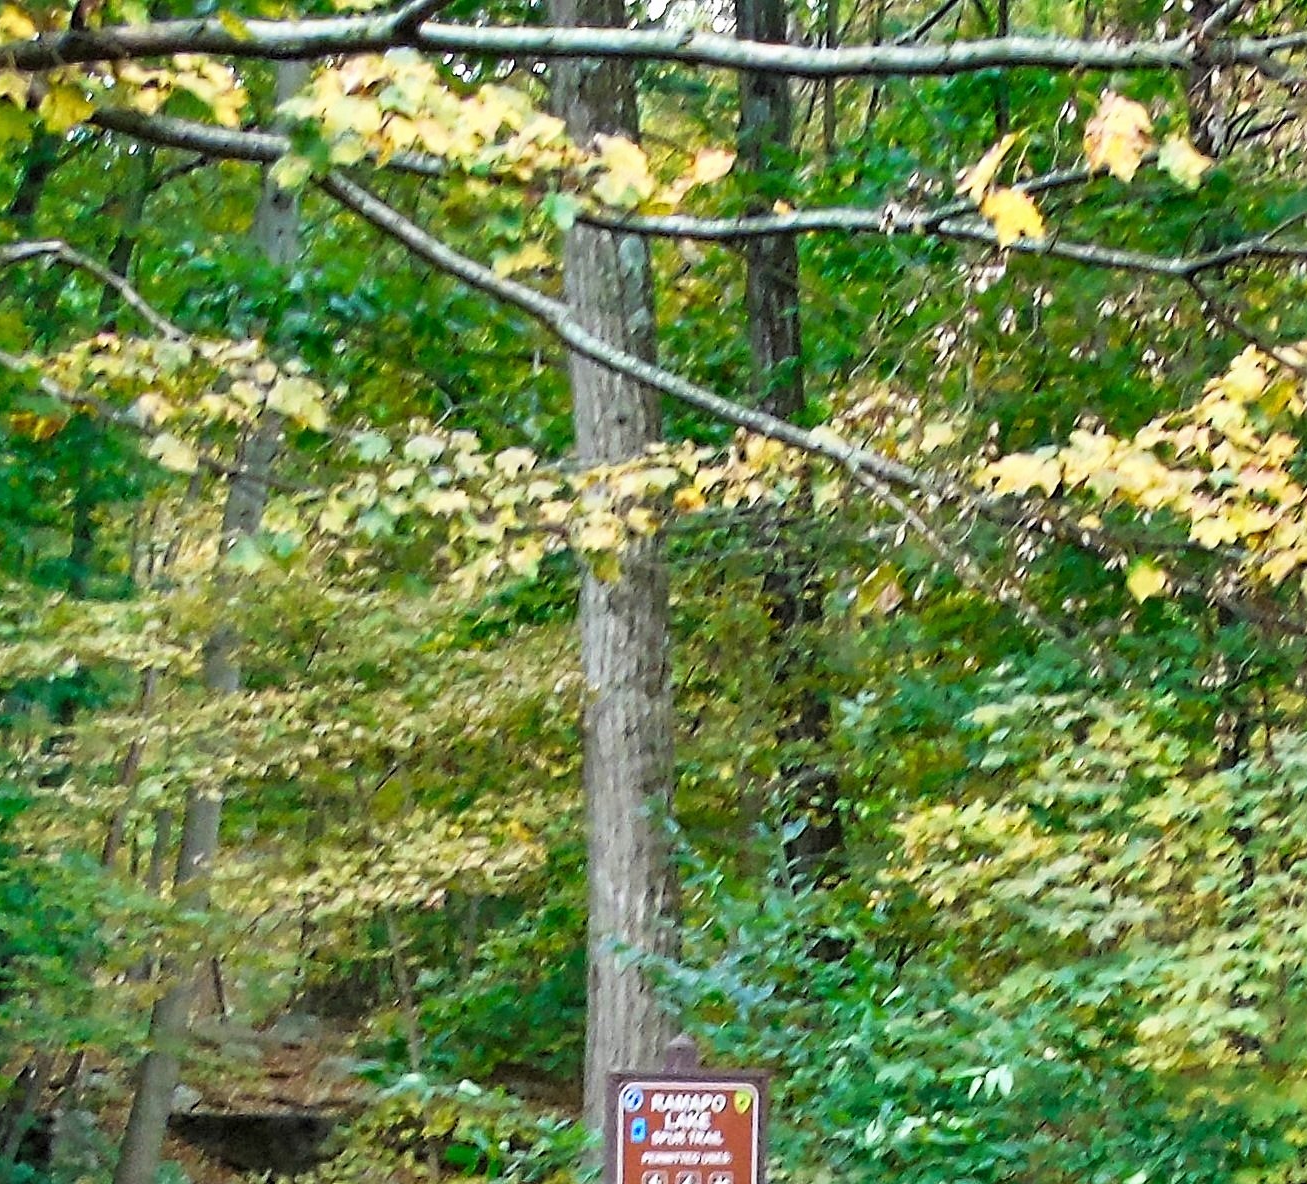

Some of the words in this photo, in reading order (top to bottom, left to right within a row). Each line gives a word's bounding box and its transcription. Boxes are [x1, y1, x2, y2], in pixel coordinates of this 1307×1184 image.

[651, 1093, 727, 1113] RAMAPO
[664, 1111, 712, 1131] LAKE
[651, 1130, 687, 1146] SPUR
[688, 1130, 725, 1146] TRAIL
